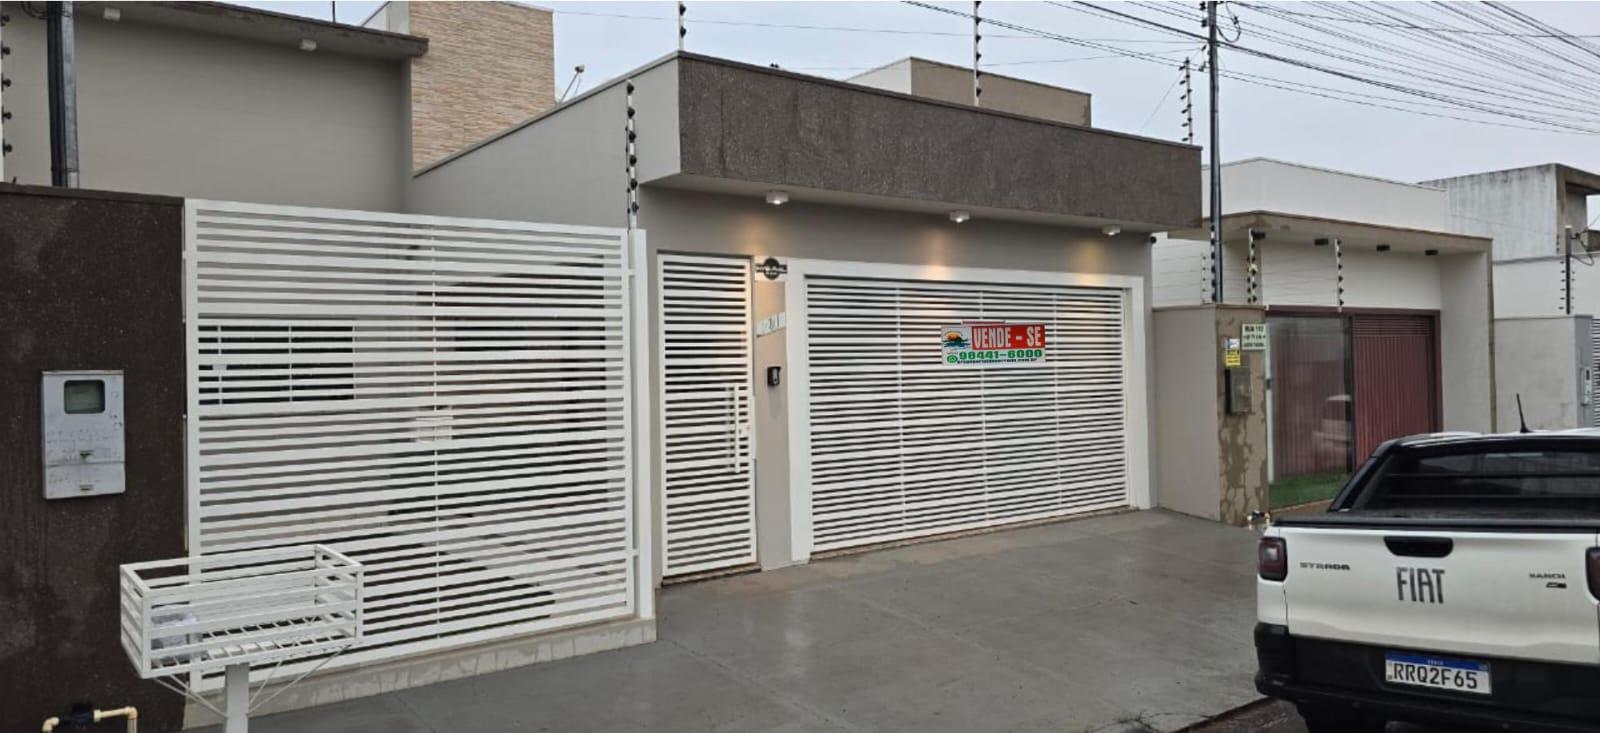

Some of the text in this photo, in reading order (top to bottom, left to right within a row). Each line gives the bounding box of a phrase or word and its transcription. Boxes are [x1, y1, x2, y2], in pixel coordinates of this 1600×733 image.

[973, 327, 1012, 349] VENDE
[1026, 326, 1042, 347] SE
[959, 349, 1043, 360] 98441-6000
[1299, 561, 1351, 571] STRADA
[1396, 566, 1446, 605] FIAT
[1393, 662, 1478, 690] RRQ2F65
